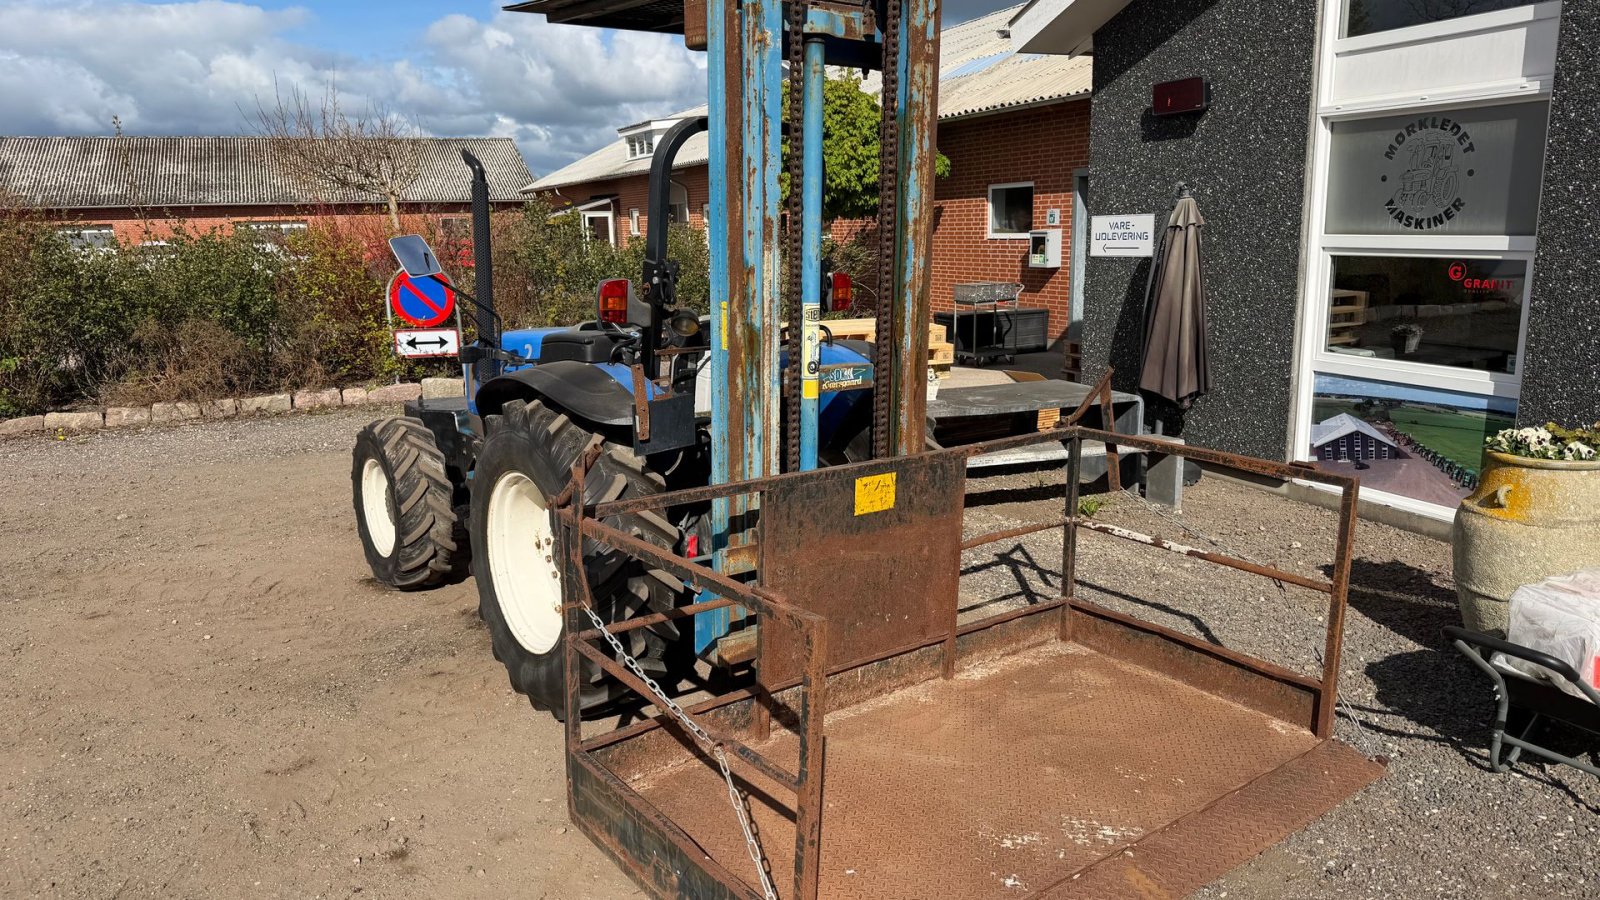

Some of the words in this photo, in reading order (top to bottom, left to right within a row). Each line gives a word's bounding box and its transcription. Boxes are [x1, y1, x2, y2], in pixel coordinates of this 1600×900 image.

[1384, 117, 1475, 160] MØRKLEDET
[1385, 198, 1466, 230] MASKINER
[1109, 221, 1135, 230] VARE-
[1095, 232, 1149, 241] UDLEVERING
[1463, 278, 1513, 289] GRANIT
